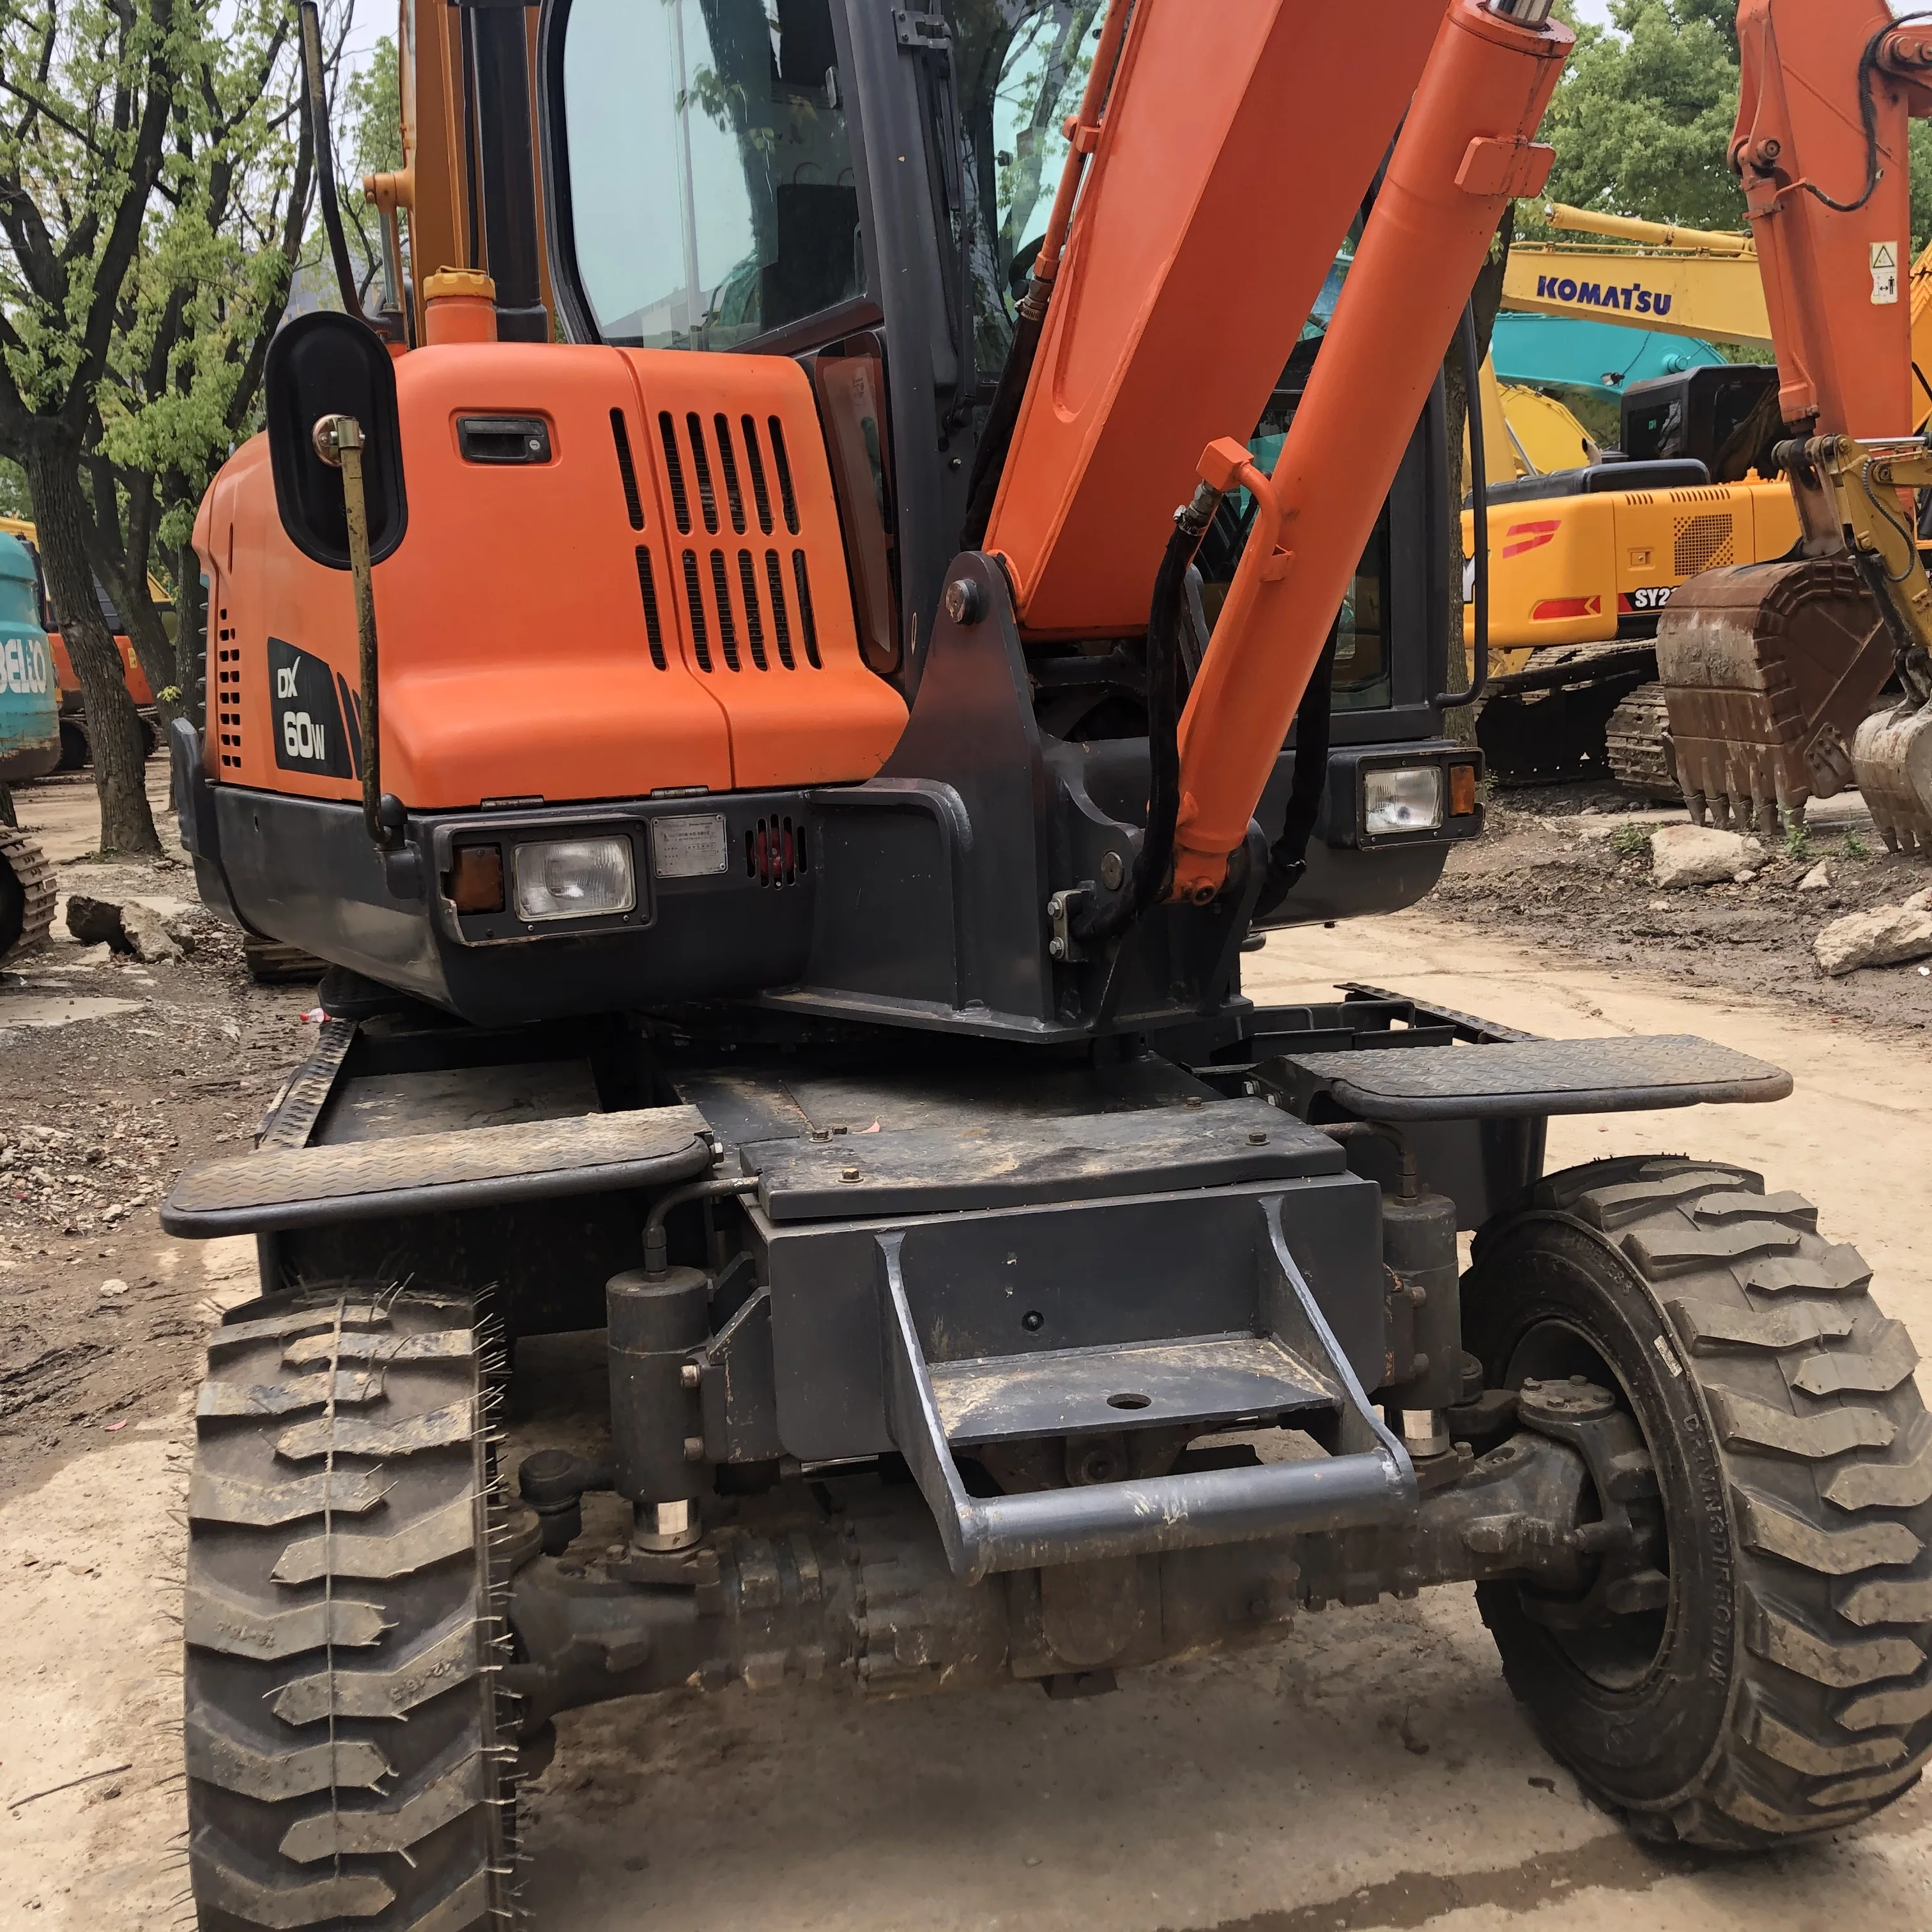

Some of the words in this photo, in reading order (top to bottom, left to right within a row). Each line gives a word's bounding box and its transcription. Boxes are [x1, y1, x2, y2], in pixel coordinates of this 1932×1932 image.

[1537, 275, 1671, 316] KOMATSU
[1635, 587, 1680, 608] SY2
[277, 656, 302, 699] DX
[283, 710, 325, 760] 60W
